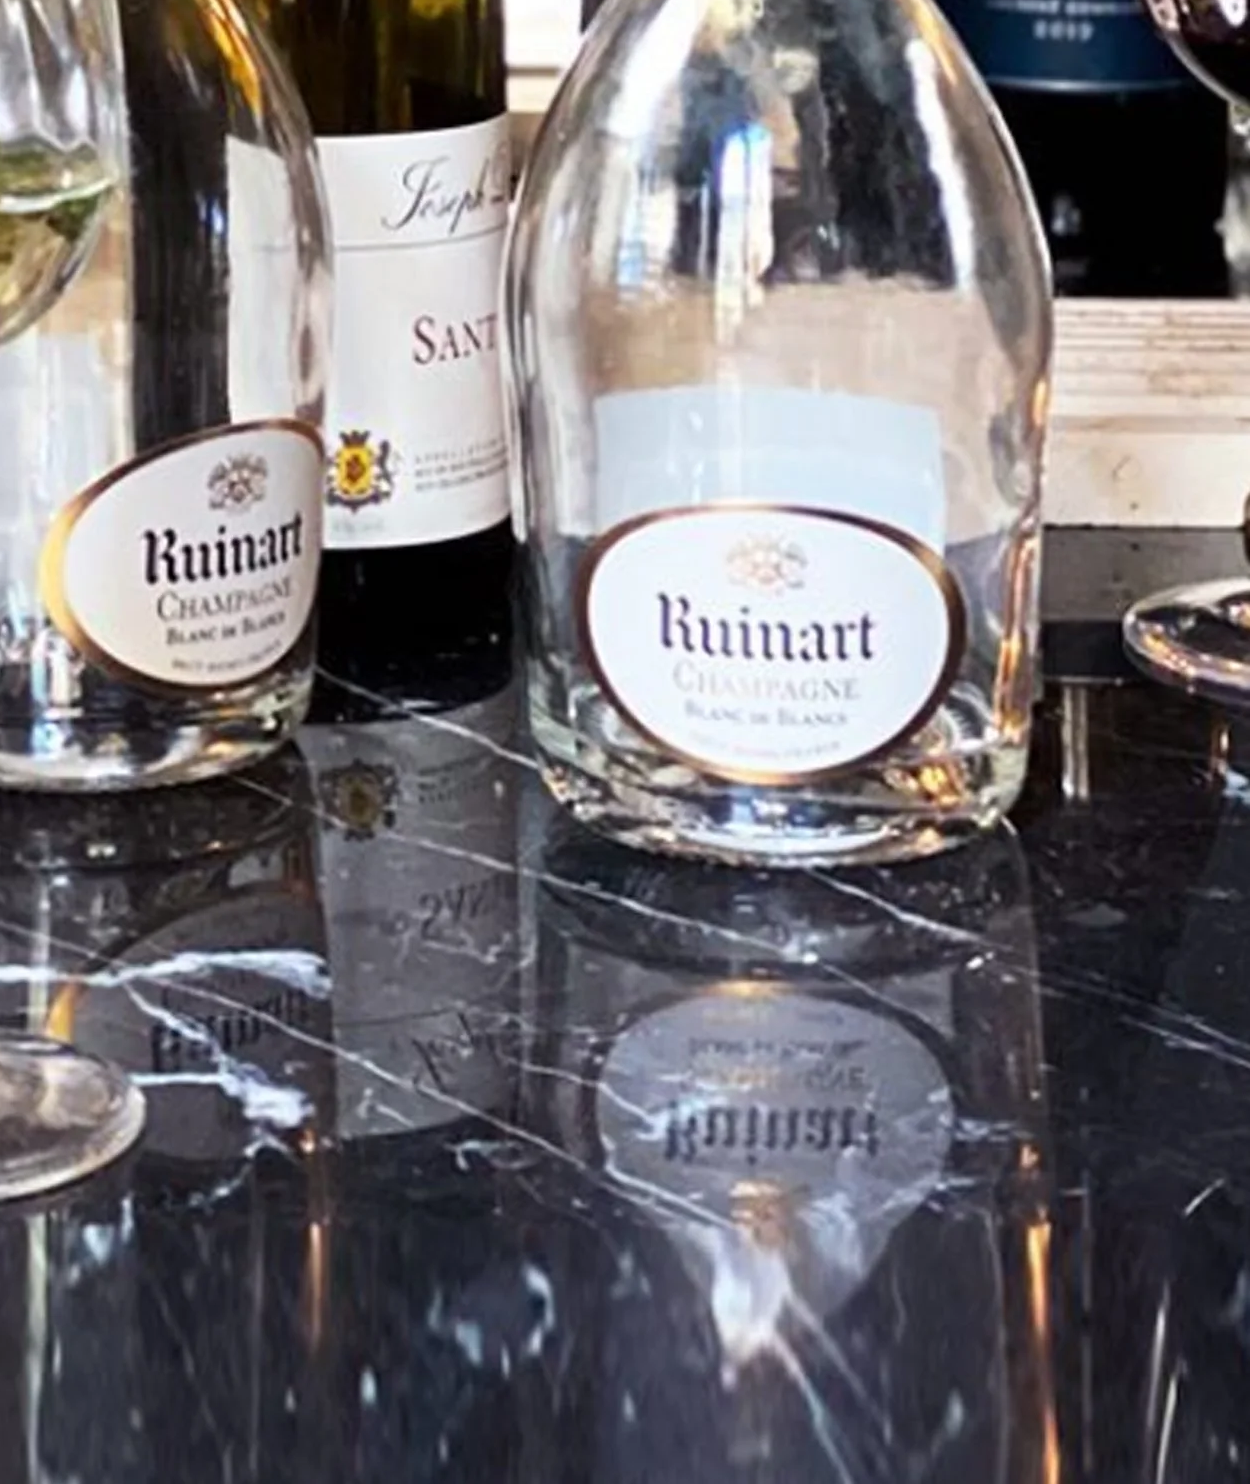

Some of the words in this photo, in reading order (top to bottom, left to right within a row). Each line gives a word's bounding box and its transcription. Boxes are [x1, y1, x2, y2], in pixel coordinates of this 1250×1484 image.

[381, 155, 491, 236] Joseph
[143, 510, 303, 587] Ruinart
[156, 576, 293, 622] CHAMPAGNE
[166, 627, 217, 646] BLANC
[657, 592, 877, 662] Ruinart
[672, 658, 861, 702] CHAMPAGNE
[684, 699, 744, 723] BLANC
[777, 706, 848, 728] BLANCS
